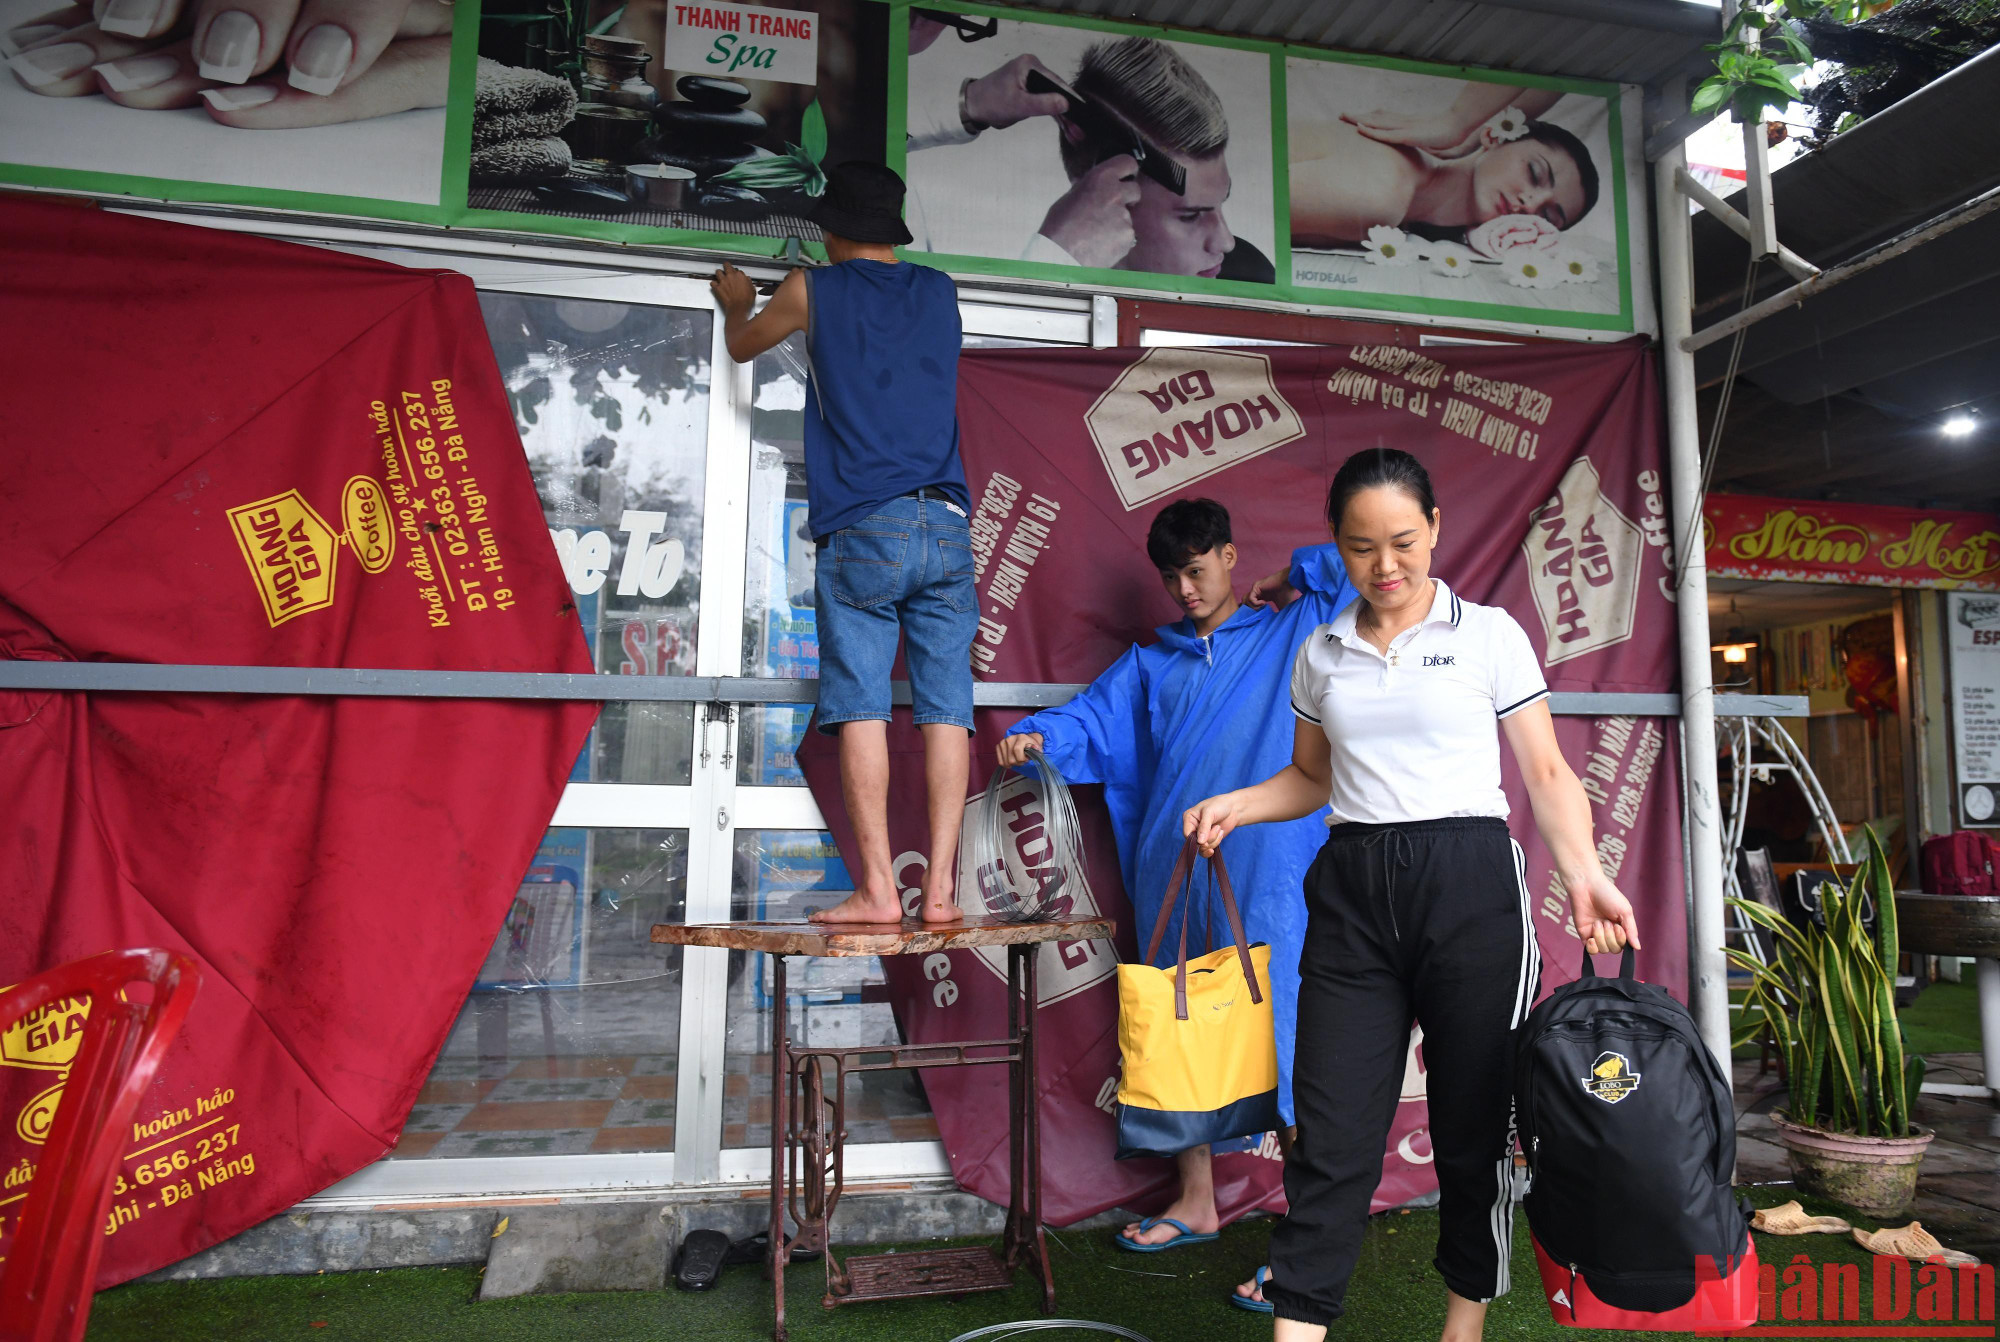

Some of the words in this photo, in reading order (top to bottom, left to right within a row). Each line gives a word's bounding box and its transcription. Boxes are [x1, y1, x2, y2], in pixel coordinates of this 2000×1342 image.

[675, 5, 740, 32] THANH
[747, 13, 811, 40] TRANG
[705, 33, 778, 73] Spa
[1137, 369, 1216, 414] GIA
[1408, 392, 1429, 418] TP
[368, 400, 390, 434] hảo
[1121, 394, 1281, 480] HOÀNG
[1440, 397, 1485, 439] NGHI
[381, 435, 400, 481] hoàn
[444, 435, 468, 462] Đà
[1516, 430, 1540, 461] 19
[391, 483, 411, 506] sự
[401, 391, 469, 556] 02363.656.237
[456, 479, 488, 523] Nghi
[1026, 493, 1061, 522] 19
[355, 486, 385, 563] Coffee
[399, 508, 421, 542] cho
[969, 471, 1023, 584] 0236.36562
[1004, 515, 1050, 566] HÀM
[248, 507, 304, 611] HOÀNG
[287, 517, 322, 581] GIA
[477, 527, 503, 573] Hàm
[616, 510, 685, 598] To
[1578, 514, 1614, 588] GIA
[459, 578, 488, 612] ĐT
[496, 588, 516, 611] 19
[987, 557, 1029, 611] NGHI
[977, 615, 1008, 646] TP
[1586, 751, 1620, 784] ĐÀ
[1541, 896, 1565, 924] 19
[27, 1012, 87, 1052] GIA
[133, 1108, 192, 1142] hoàn
[197, 1087, 236, 1117] hảo
[113, 1124, 241, 1196] 3.656.237
[104, 1199, 141, 1236] ghi
[161, 1178, 194, 1208] Đà
[197, 1152, 255, 1193] Nẵng
